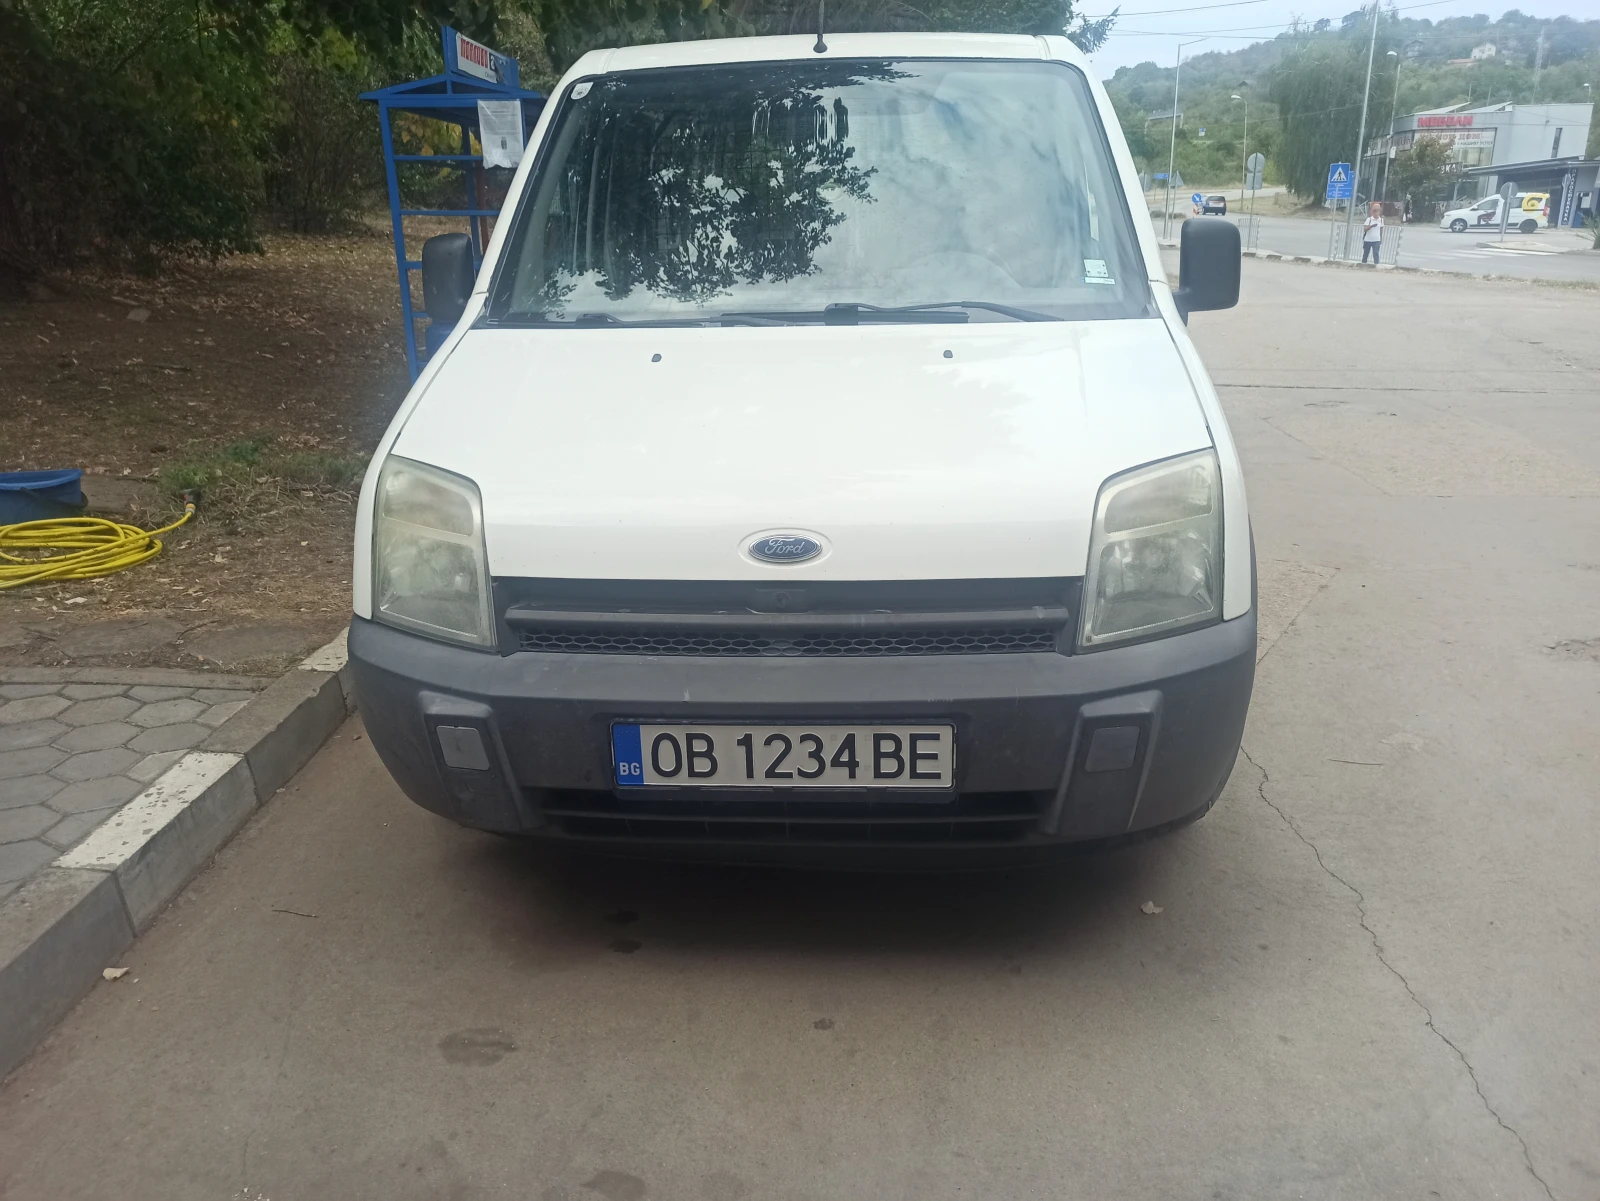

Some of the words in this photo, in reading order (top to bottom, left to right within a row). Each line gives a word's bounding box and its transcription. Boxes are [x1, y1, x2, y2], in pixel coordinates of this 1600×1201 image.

[764, 537, 805, 555] Ford
[651, 732, 718, 778] OB
[736, 732, 860, 779] 1234
[872, 733, 942, 780] BE
[619, 762, 641, 776] BG
